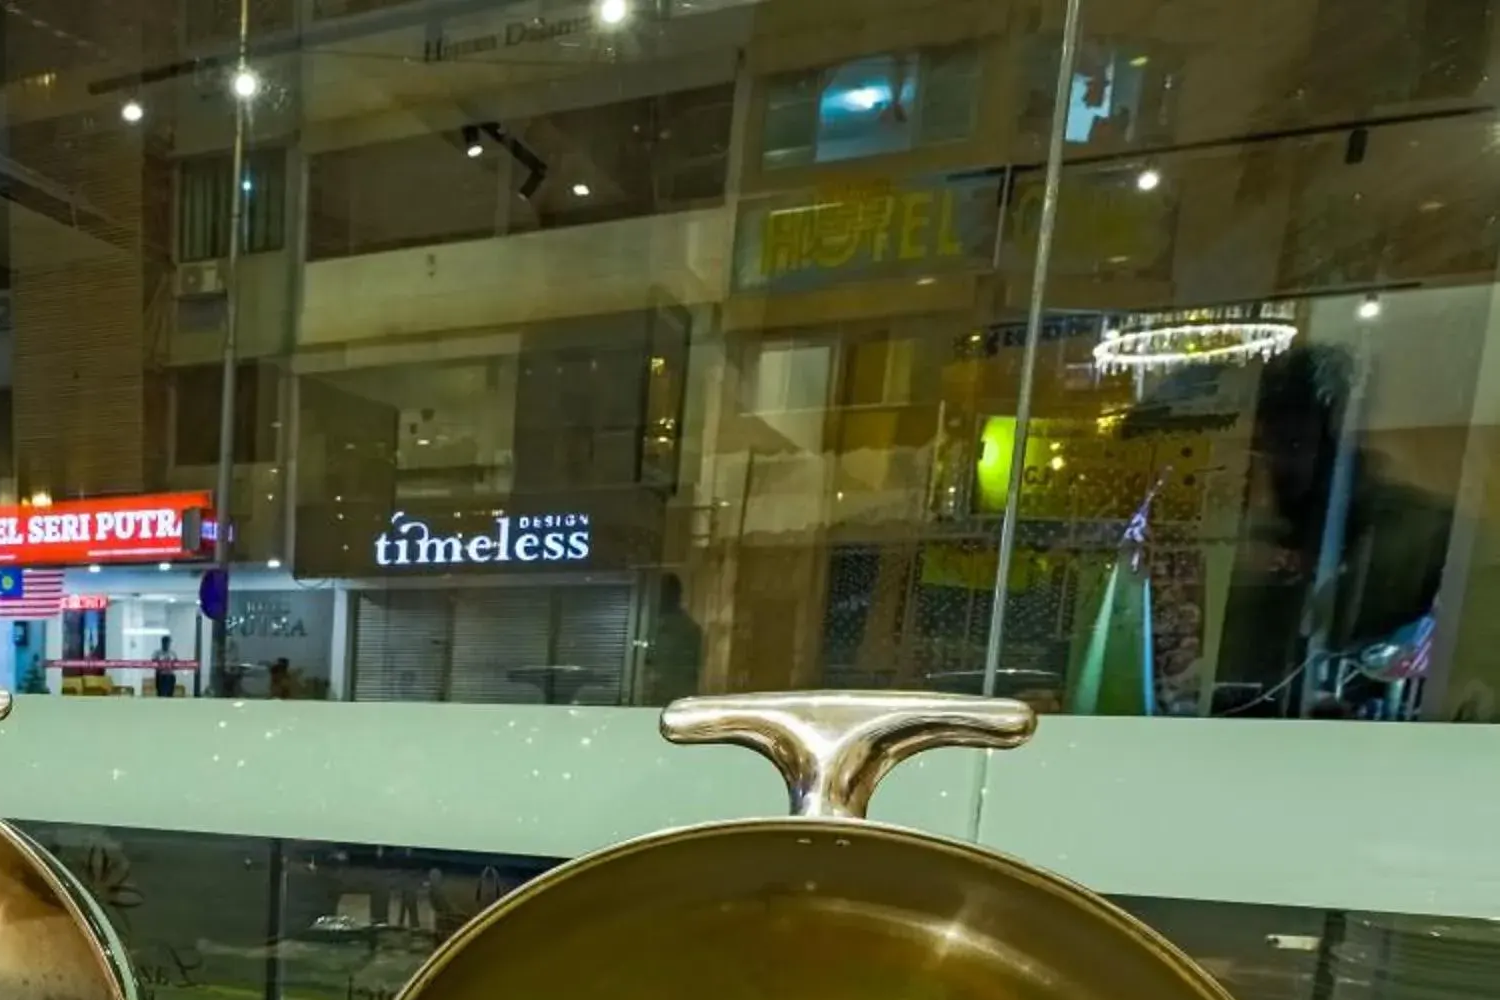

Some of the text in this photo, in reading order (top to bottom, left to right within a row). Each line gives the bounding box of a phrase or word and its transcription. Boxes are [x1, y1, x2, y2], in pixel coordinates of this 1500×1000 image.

[28, 513, 92, 544] SERI
[95, 509, 183, 541] PUTR
[374, 511, 589, 565] timeless
[519, 513, 589, 529] DESIGN
